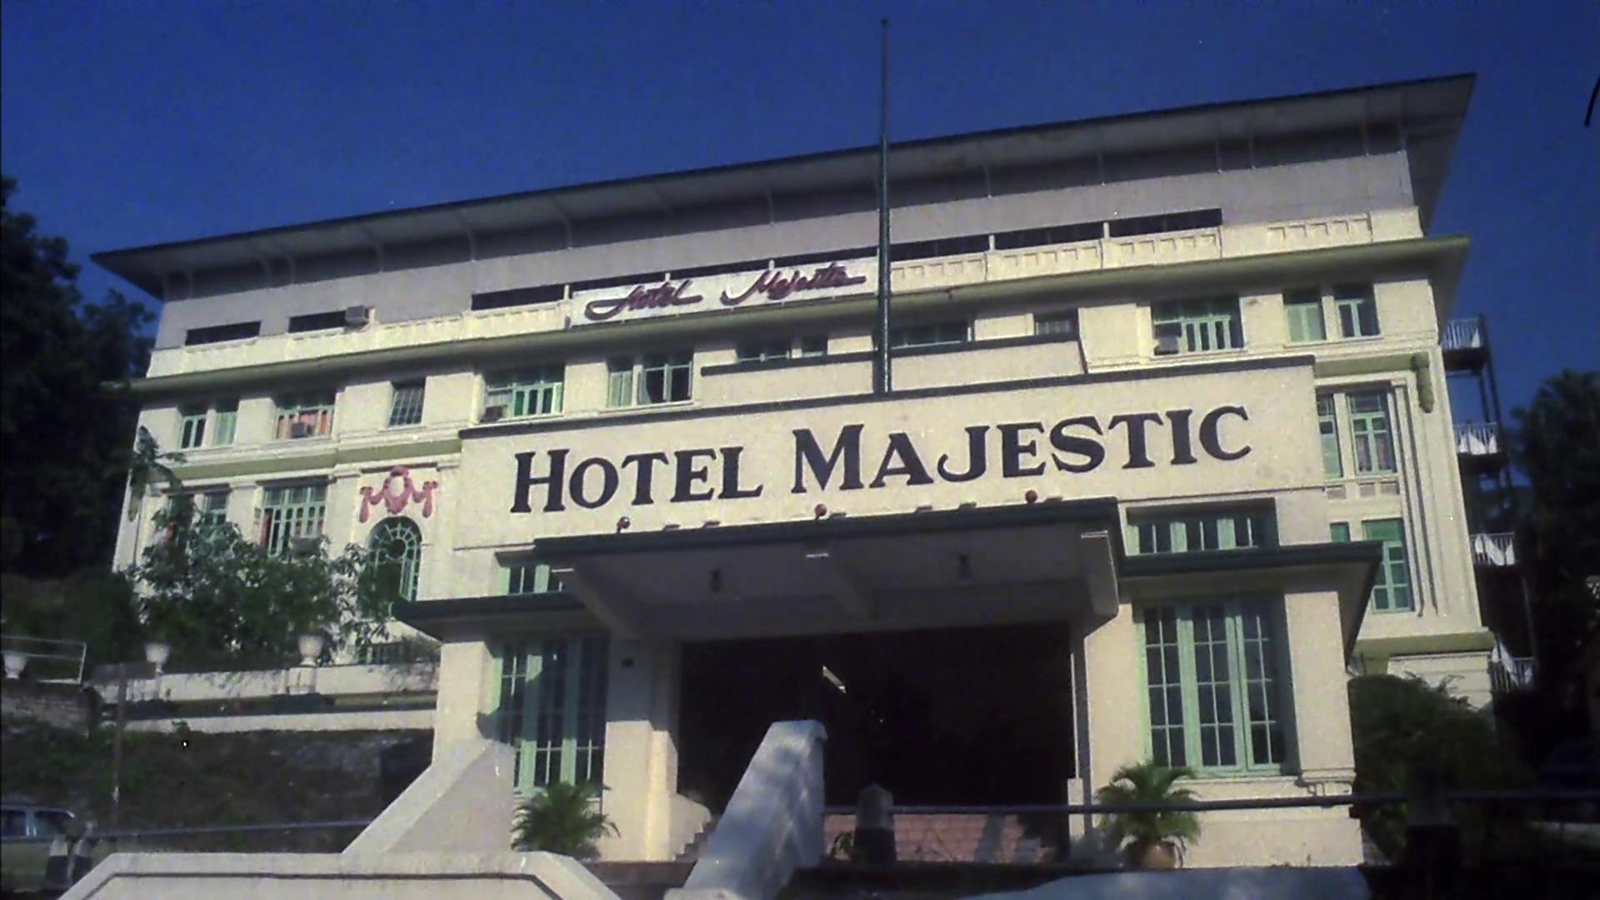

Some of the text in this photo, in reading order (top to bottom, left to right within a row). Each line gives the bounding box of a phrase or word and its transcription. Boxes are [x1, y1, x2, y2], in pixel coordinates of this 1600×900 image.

[585, 280, 703, 321] Hotel
[510, 406, 1252, 513] HOTEL MAJESTIC
